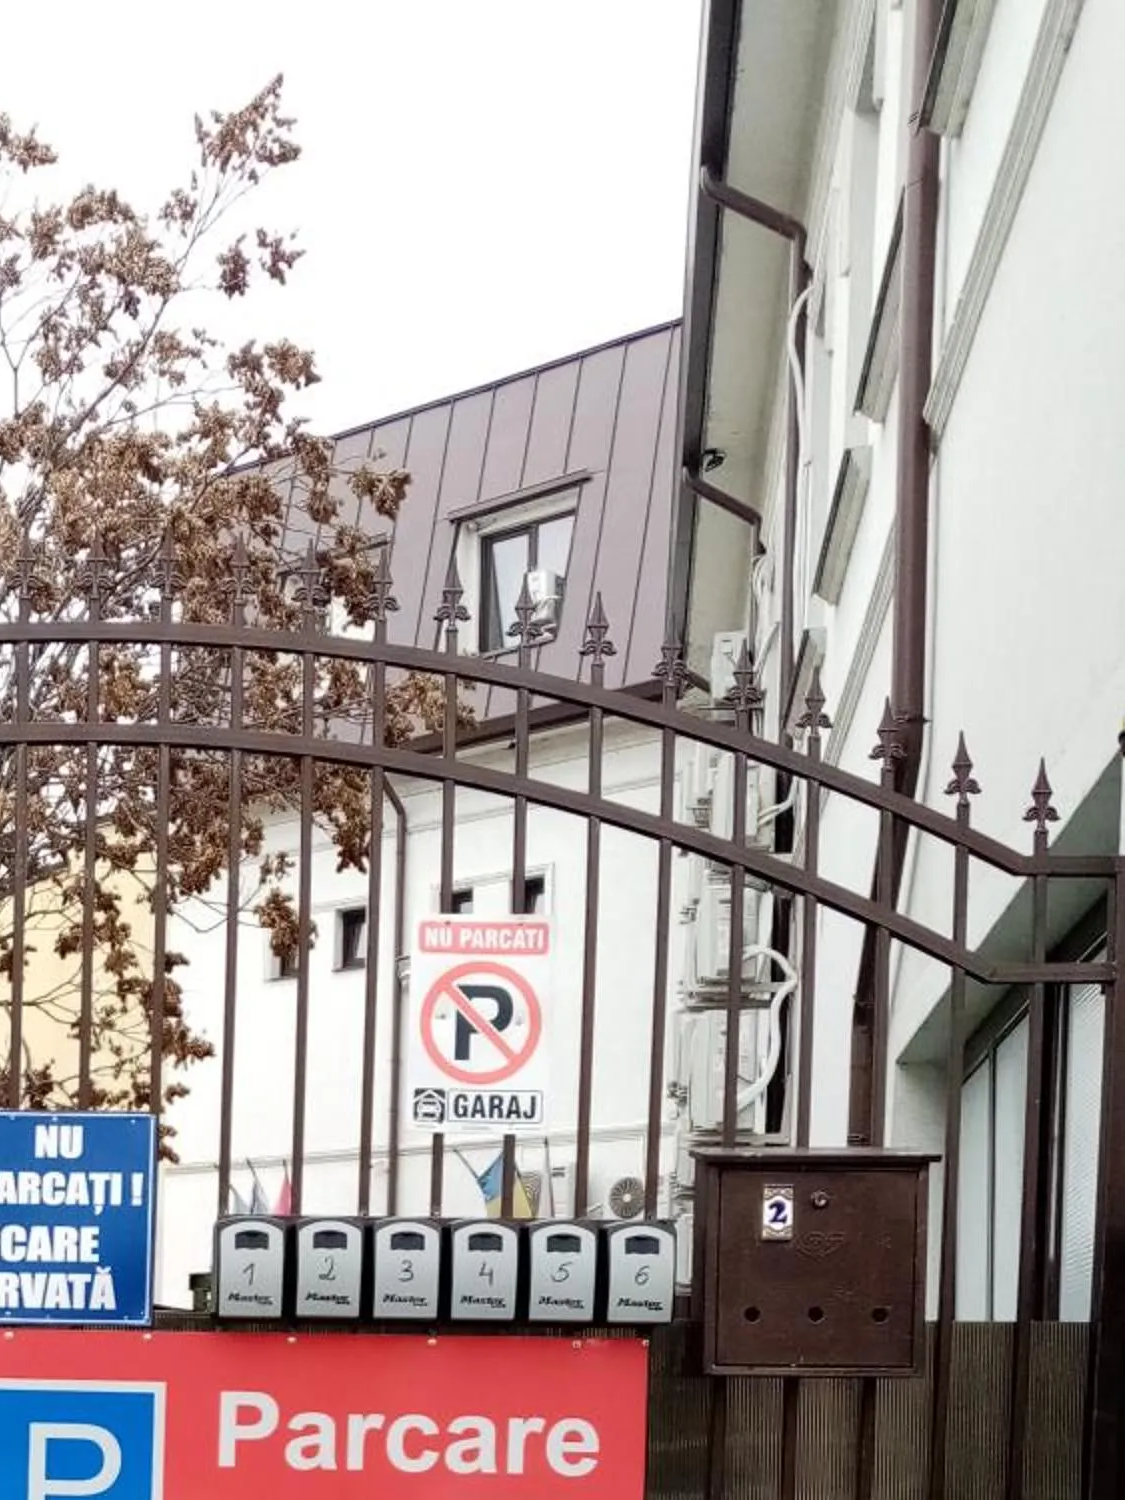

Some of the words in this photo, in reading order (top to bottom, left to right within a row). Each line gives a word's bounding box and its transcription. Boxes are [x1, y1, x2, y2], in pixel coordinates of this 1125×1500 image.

[425, 927, 453, 947] NU
[459, 928, 544, 949] PARCATI
[453, 1093, 537, 1119] GARAJ
[34, 1124, 84, 1159] NU
[768, 1201, 788, 1224] 2
[241, 1262, 256, 1286] 1
[318, 1255, 337, 1281] 2
[398, 1259, 414, 1282] 3
[478, 1260, 494, 1287] 4
[550, 1261, 575, 1282] 5
[634, 1265, 651, 1285] 6
[218, 1391, 600, 1477] Parcare
